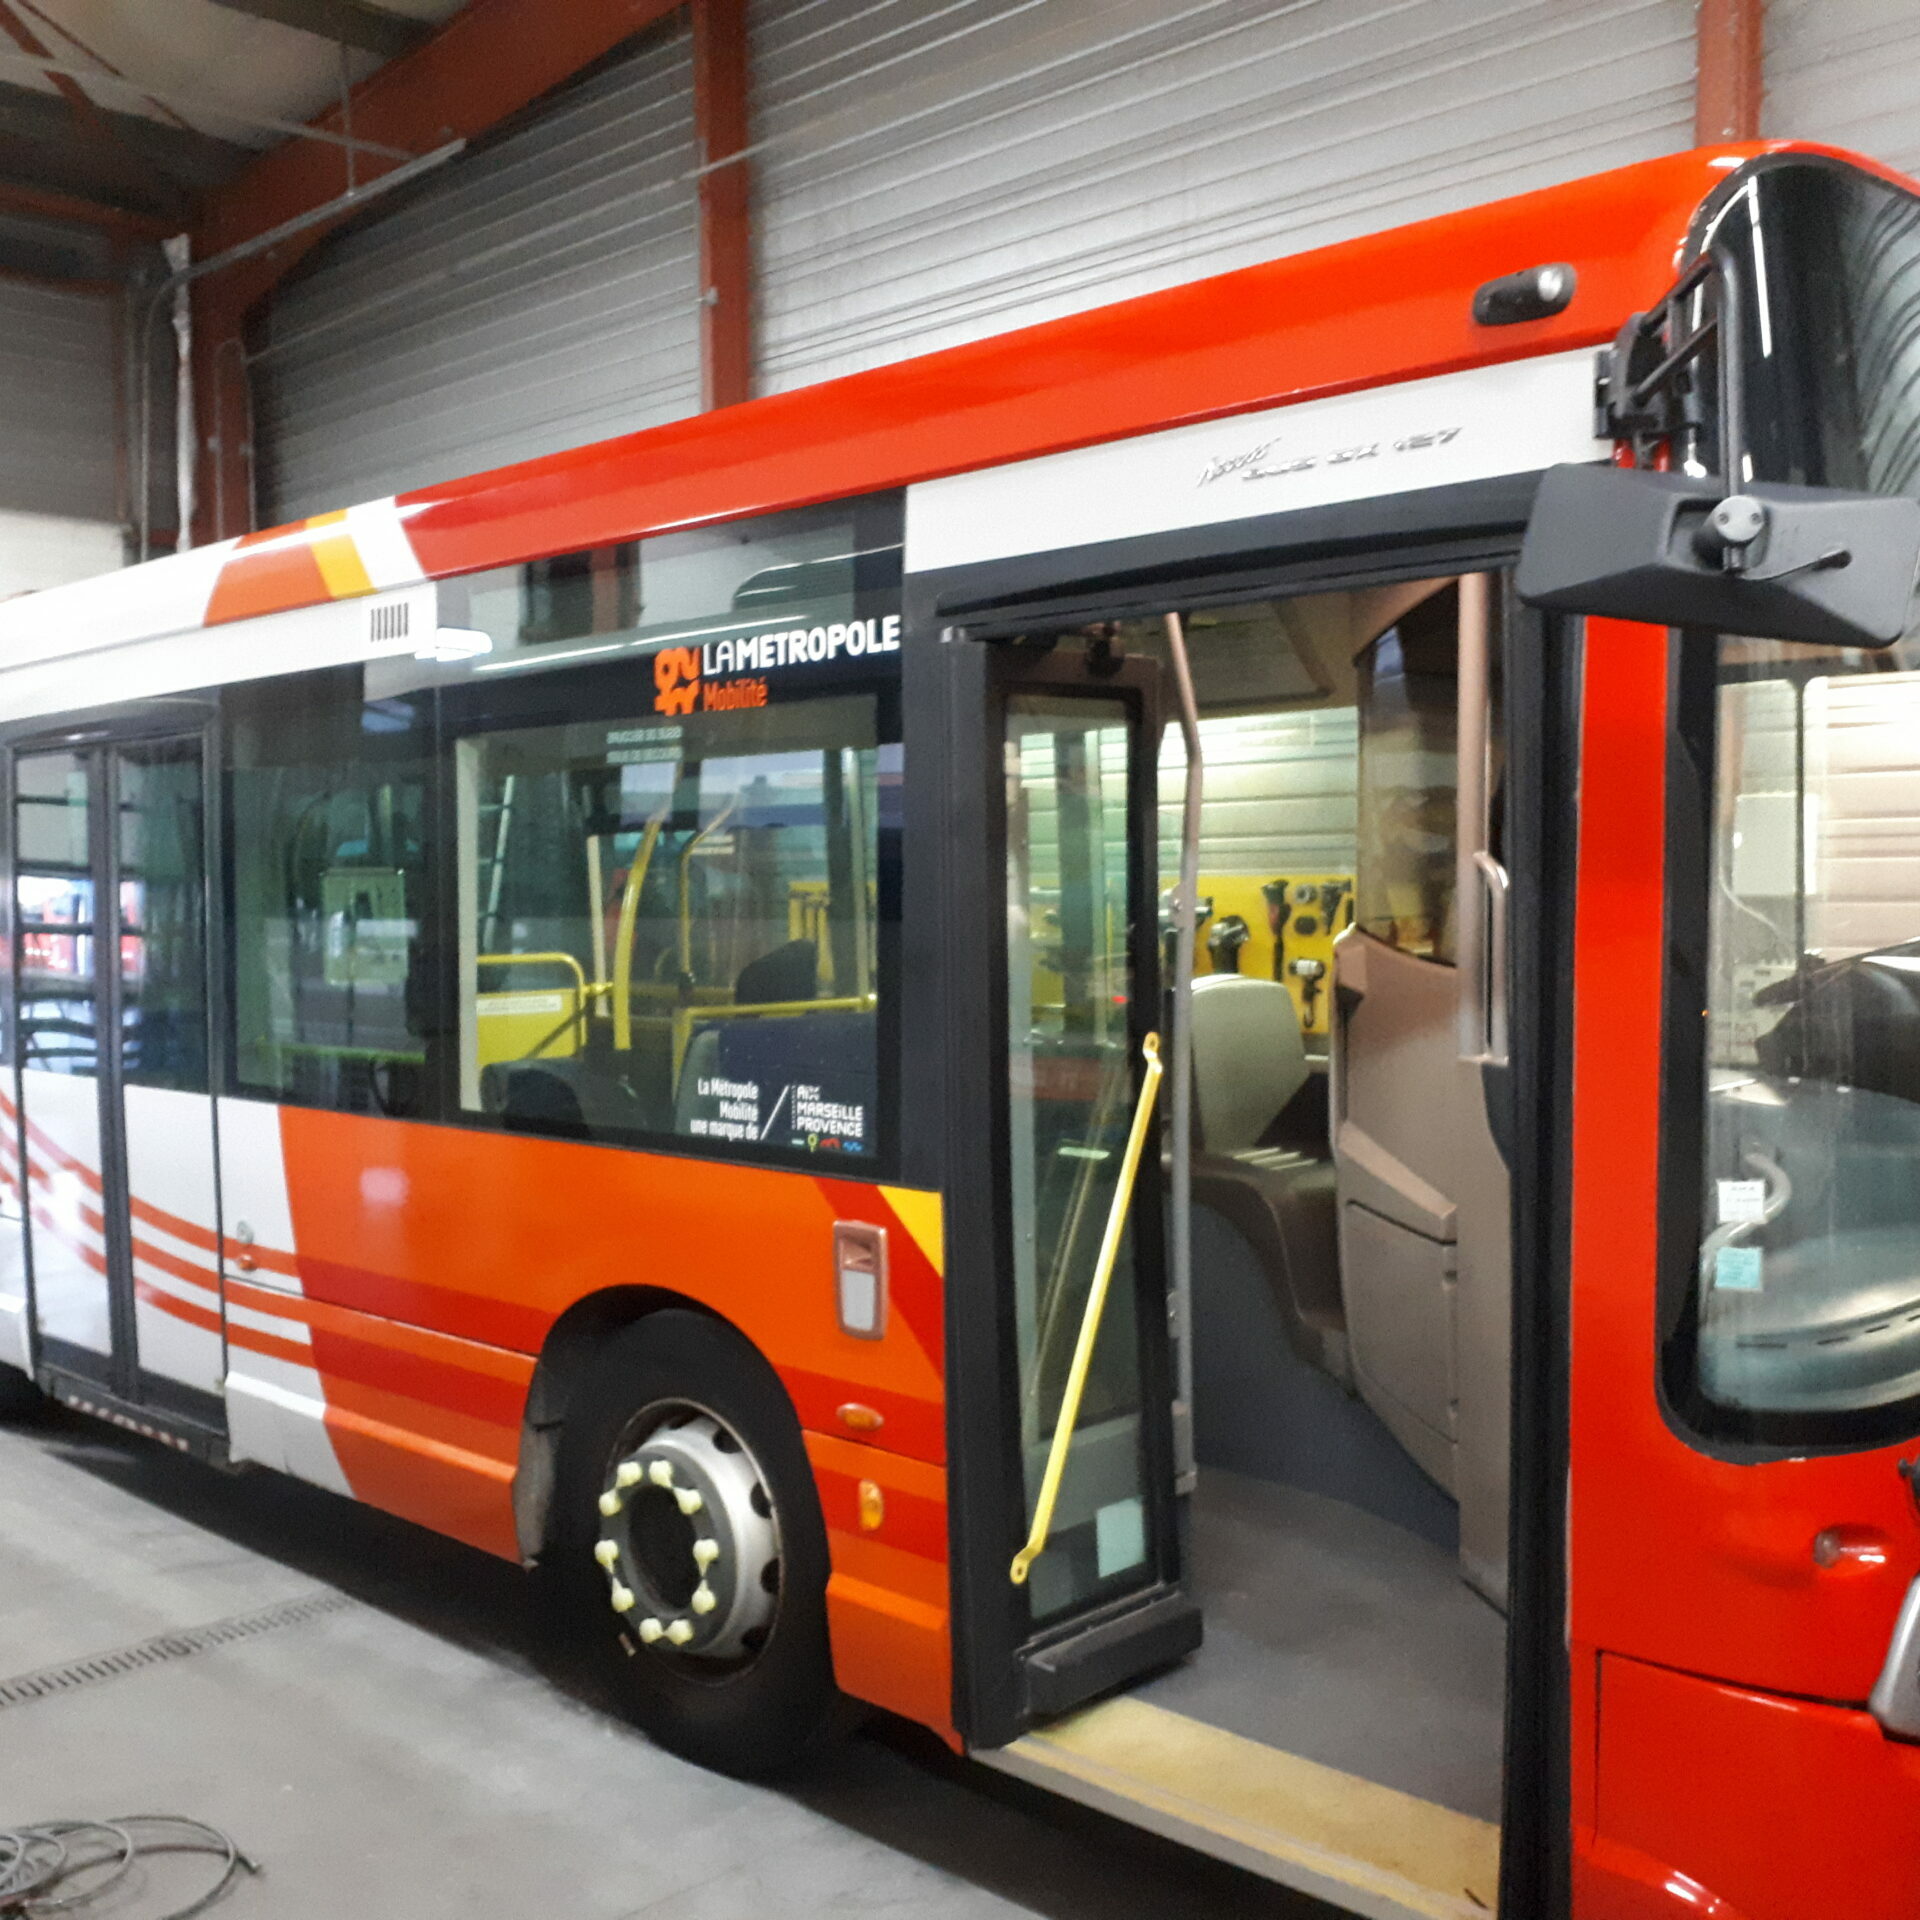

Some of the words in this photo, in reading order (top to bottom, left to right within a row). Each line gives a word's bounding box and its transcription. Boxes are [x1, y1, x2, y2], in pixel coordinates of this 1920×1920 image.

[703, 675, 768, 712] Mobilité
[697, 1077, 709, 1096] La
[719, 1100, 759, 1122] Mobilité
[690, 1119, 707, 1135] une
[708, 1121, 744, 1142] marque
[745, 1122, 759, 1140] de
[796, 1116, 864, 1138] PROVENCE
